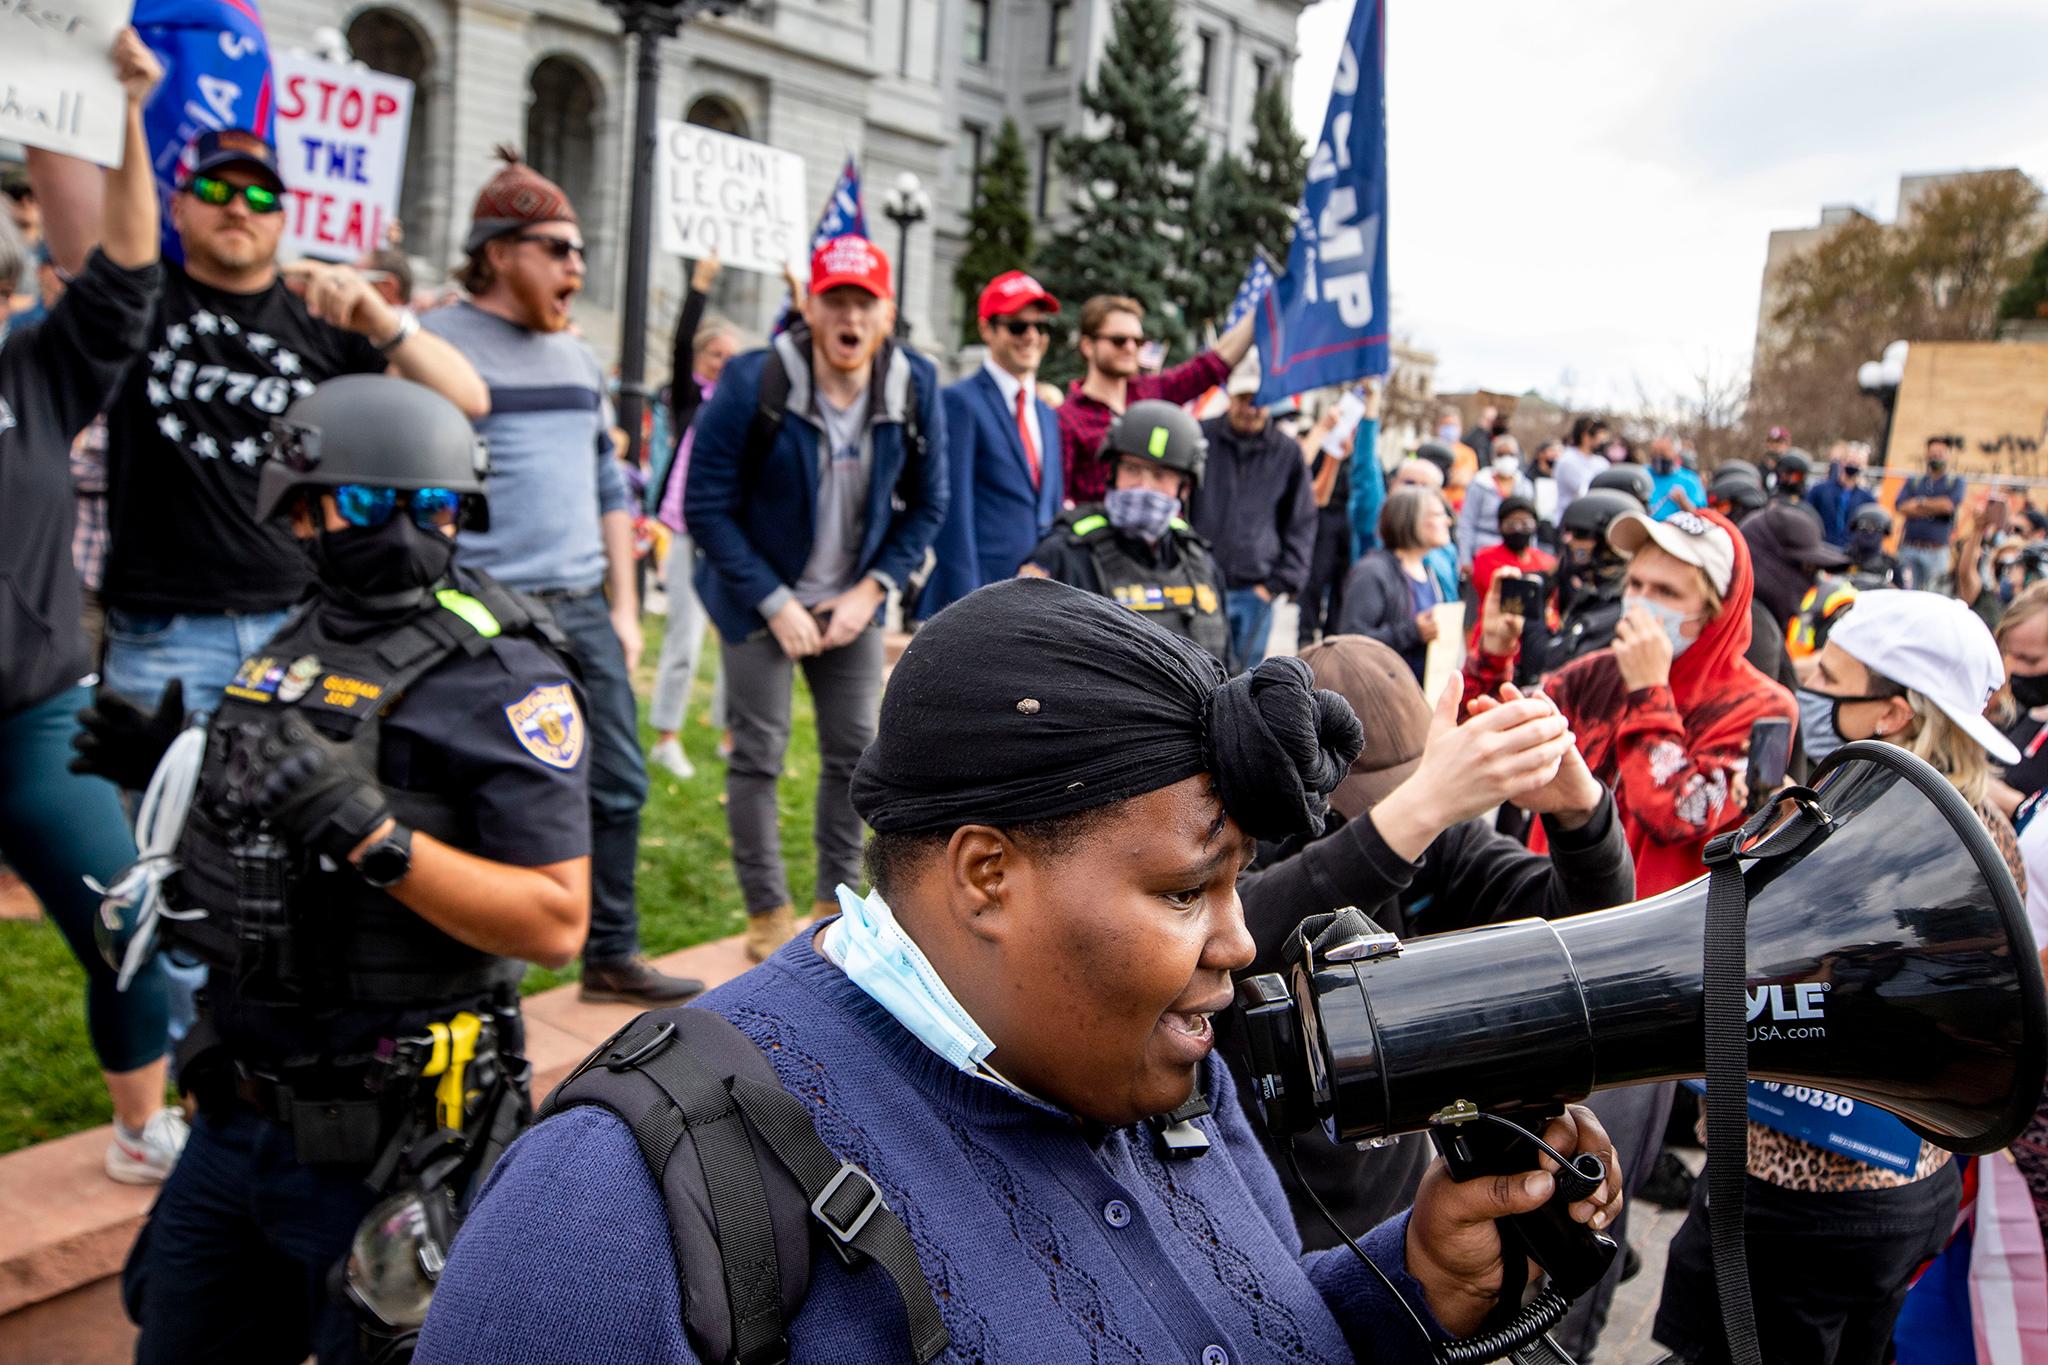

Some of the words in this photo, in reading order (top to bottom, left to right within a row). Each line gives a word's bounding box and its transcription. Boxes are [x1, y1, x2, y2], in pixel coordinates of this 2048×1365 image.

[278, 76, 397, 134] STOP
[301, 136, 368, 184] THE
[670, 167, 794, 226] LEGAL
[671, 214, 792, 262] VOTES
[169, 359, 291, 414] 1776
